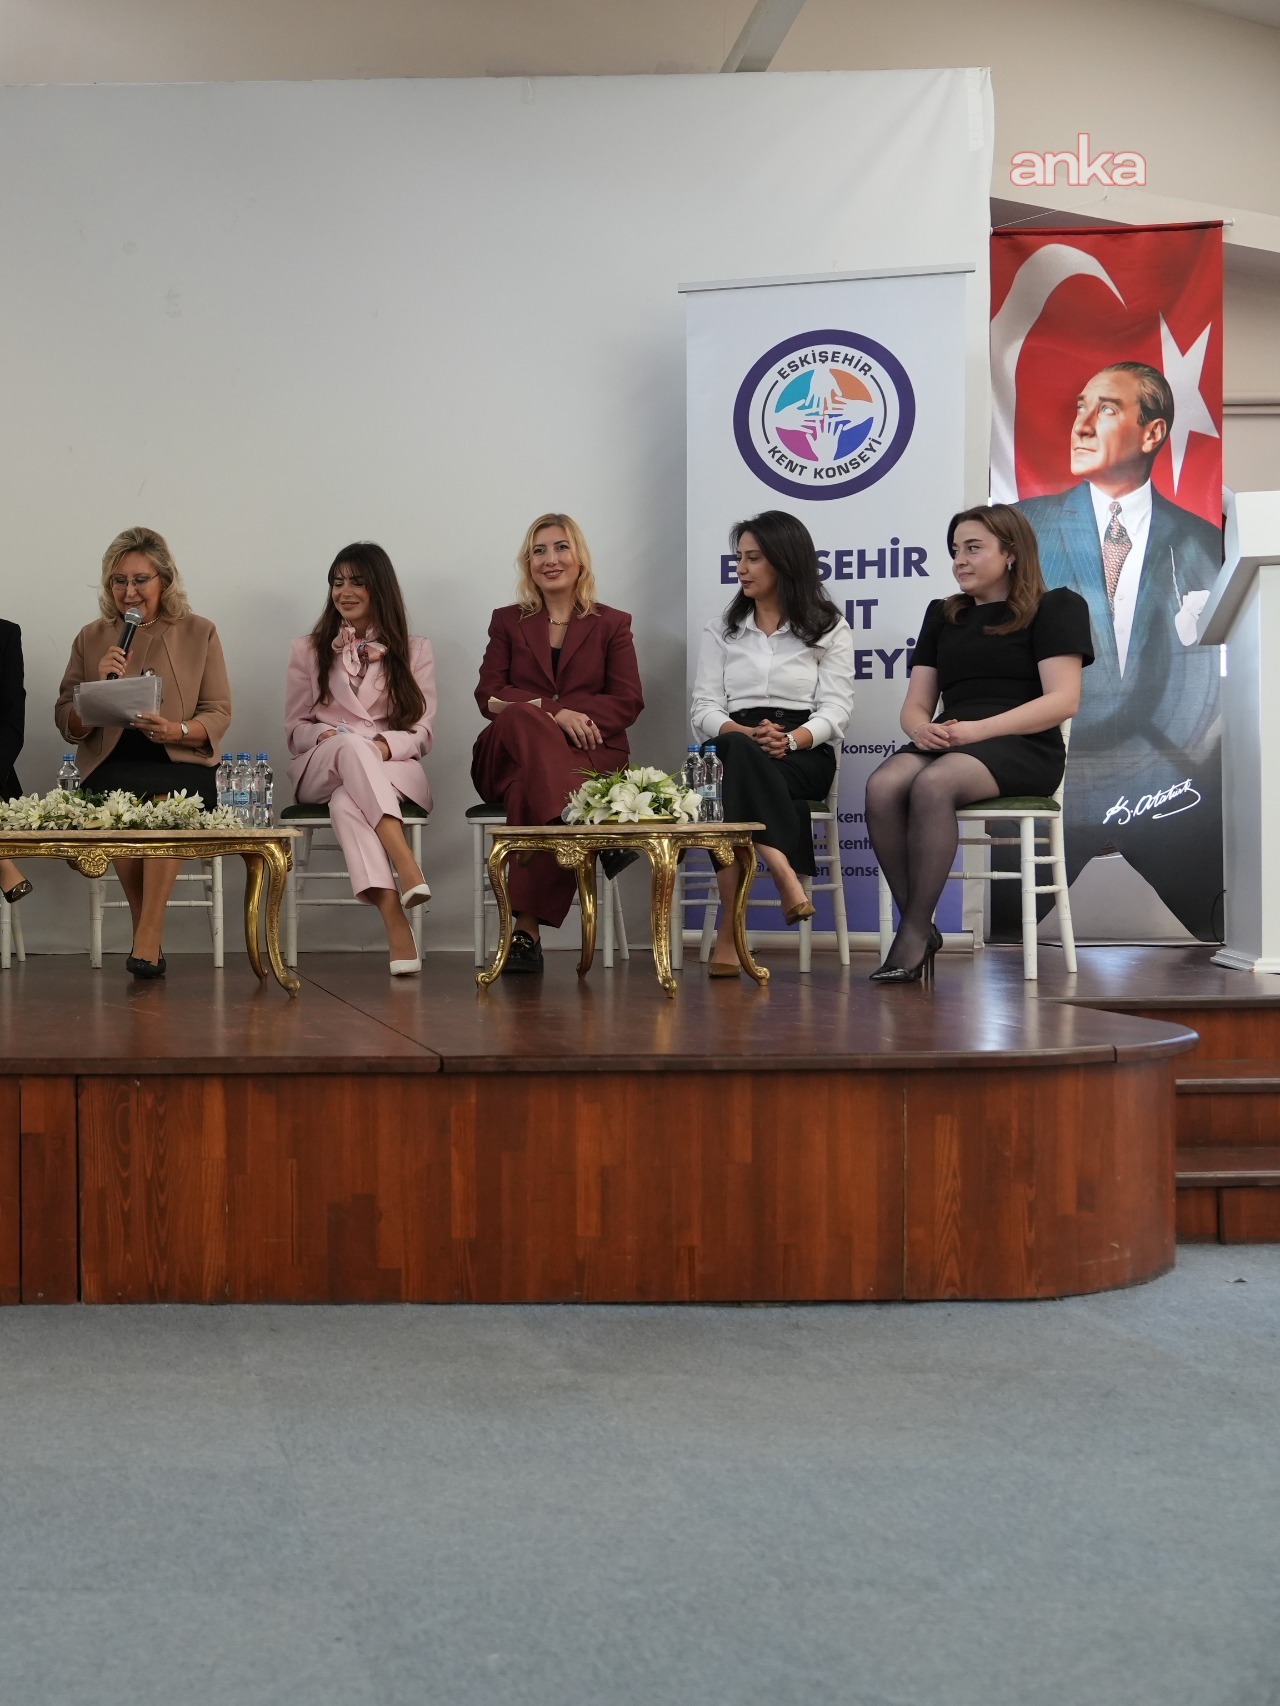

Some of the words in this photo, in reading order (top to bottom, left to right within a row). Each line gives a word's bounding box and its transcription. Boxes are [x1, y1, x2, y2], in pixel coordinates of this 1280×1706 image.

[777, 350, 873, 380] ESKİŞEHİR
[768, 446, 807, 476] KENT
[813, 437, 882, 479] KONSEYİ
